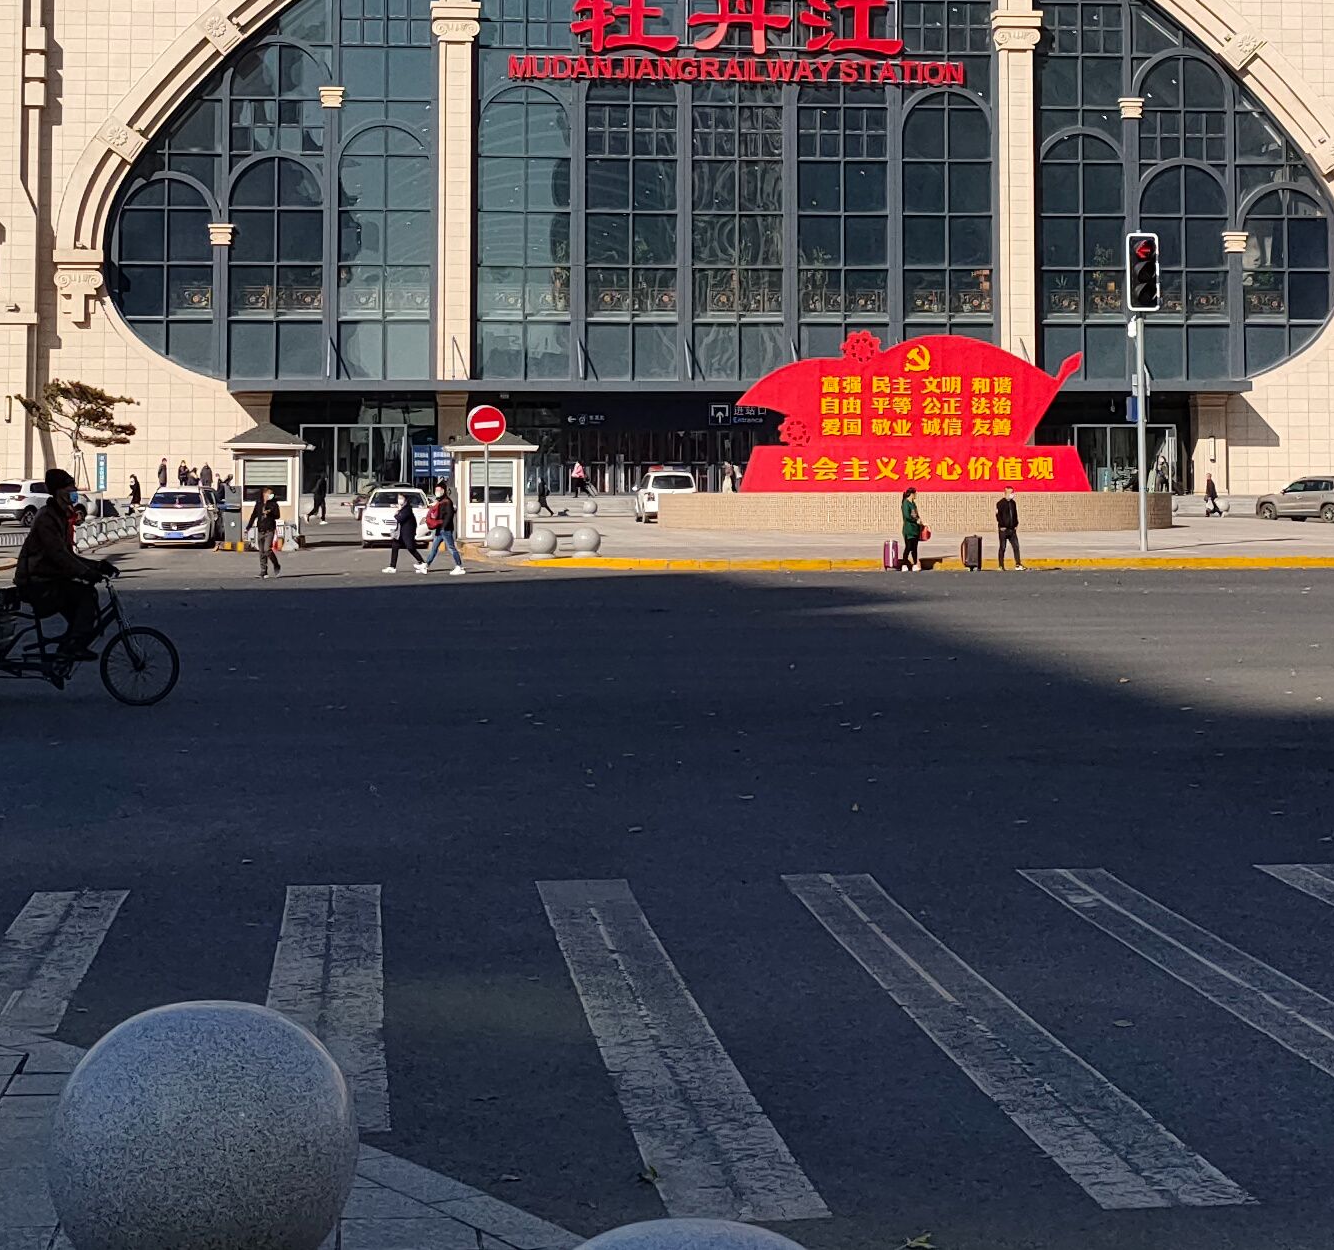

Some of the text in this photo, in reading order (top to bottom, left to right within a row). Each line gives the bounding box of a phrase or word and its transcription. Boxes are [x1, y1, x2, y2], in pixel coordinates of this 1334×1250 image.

[840, 60, 964, 85] STATION
[821, 376, 1012, 394] 富强 民主 文明 和谐
[821, 397, 1012, 415] 自由 平等 公正 法治
[821, 418, 1012, 436] 爱国 敬业 诚信 友善
[781, 456, 1055, 481] 社会主义核心价值观
